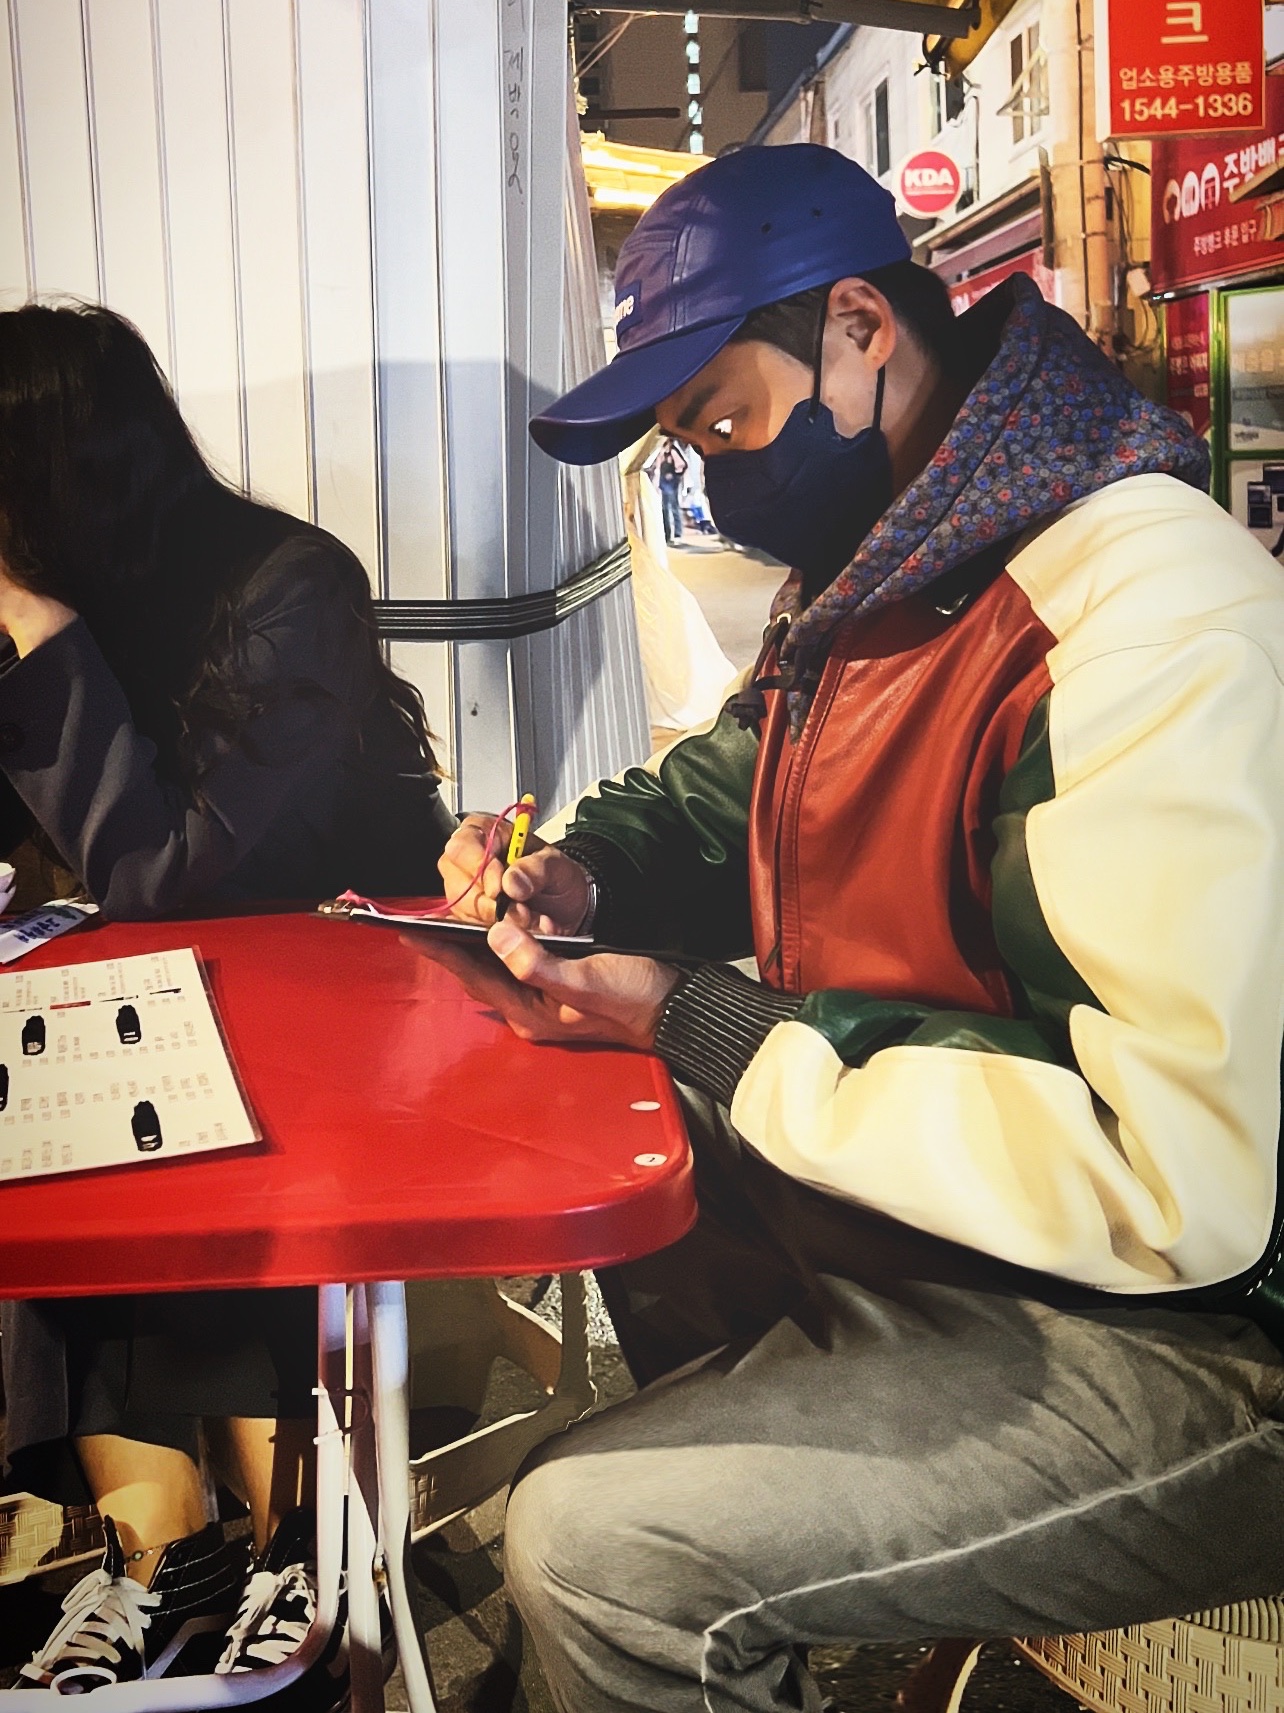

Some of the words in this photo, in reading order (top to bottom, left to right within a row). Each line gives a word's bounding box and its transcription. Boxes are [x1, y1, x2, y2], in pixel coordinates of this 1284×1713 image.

[1160, 1, 1209, 44] 크
[1119, 62, 1253, 90] 업소용주방용품
[1120, 92, 1253, 121] 1544-1336
[904, 167, 955, 187] KDA
